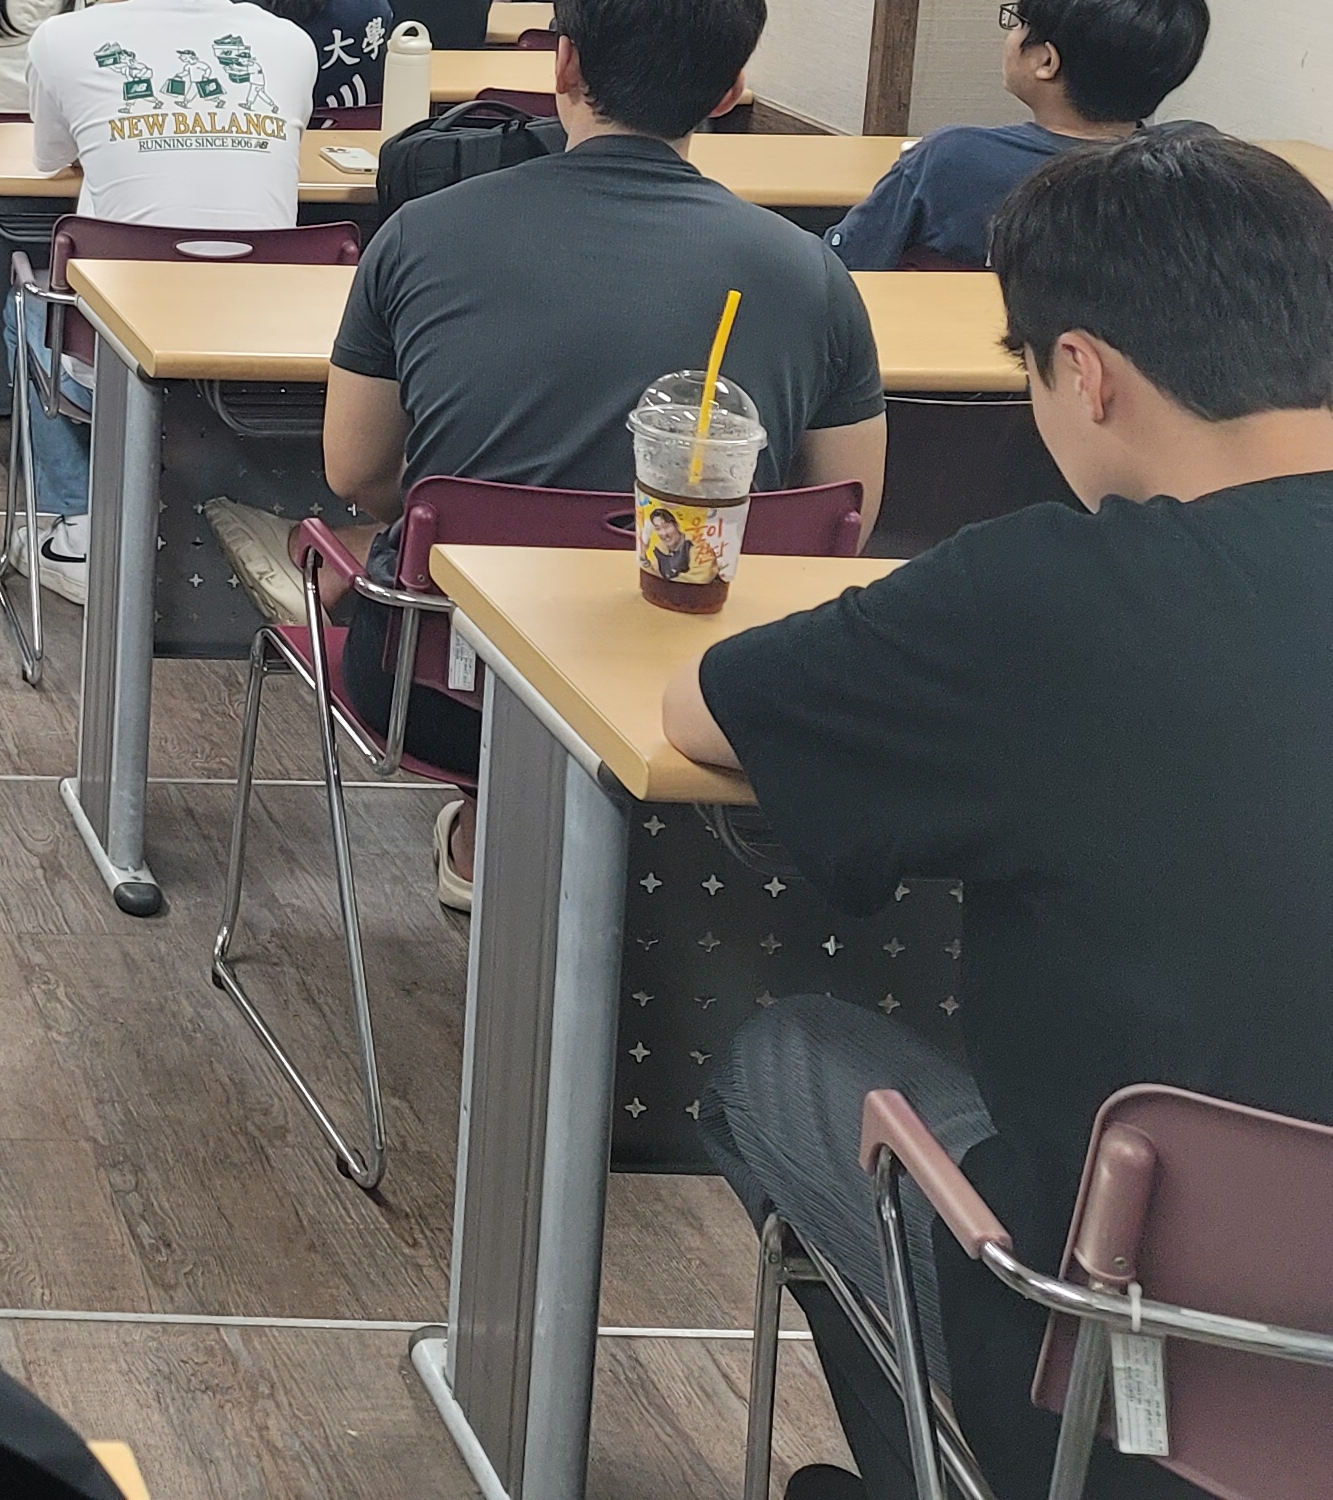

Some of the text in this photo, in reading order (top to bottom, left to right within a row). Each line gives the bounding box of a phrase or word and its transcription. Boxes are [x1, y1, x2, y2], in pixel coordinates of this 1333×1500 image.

[108, 111, 288, 142] NEW BALANCE
[138, 137, 193, 150] RUNNING
[195, 137, 229, 148] SINCE
[231, 138, 253, 149] 1906
